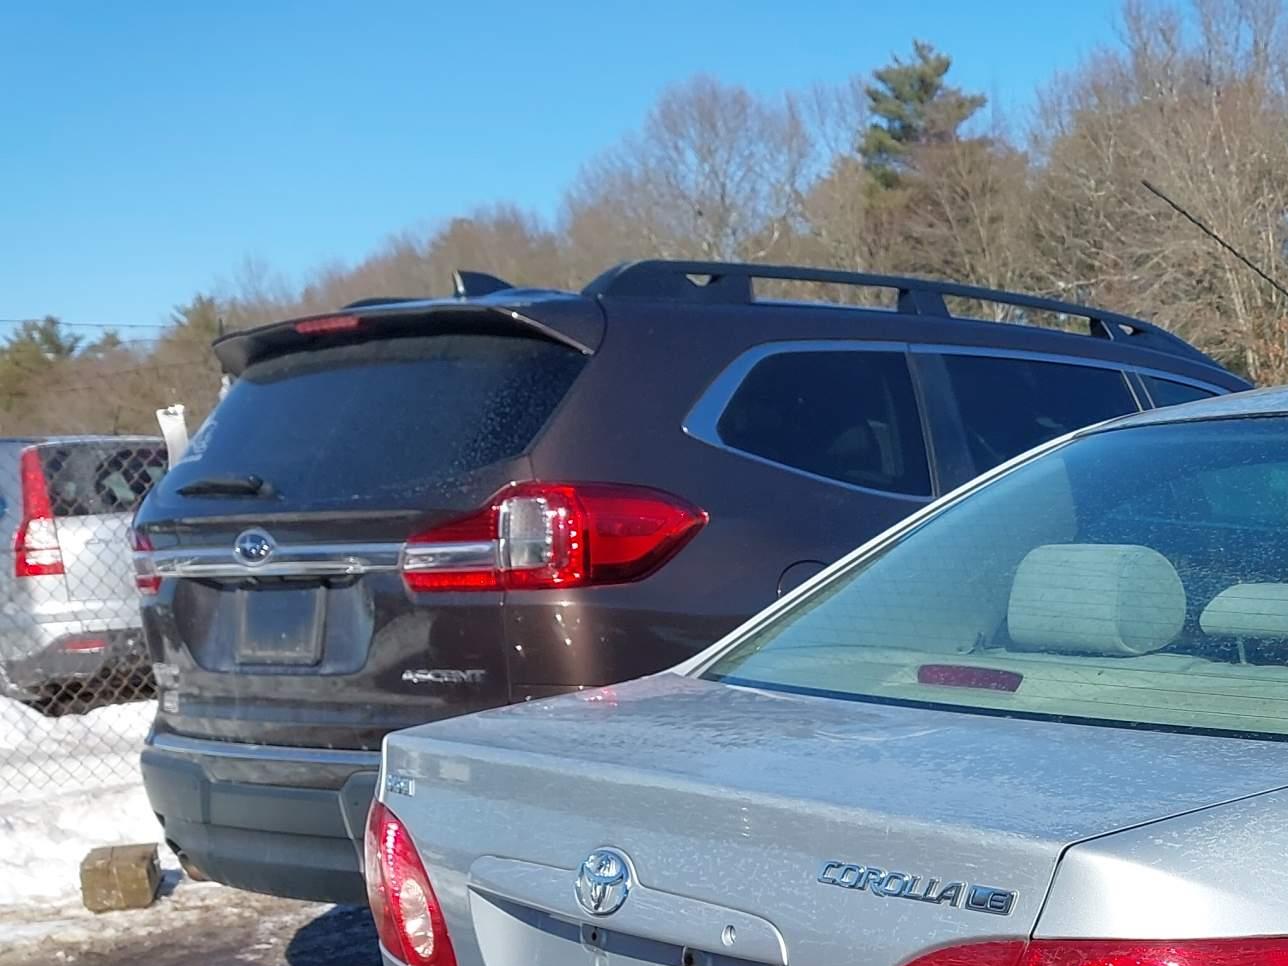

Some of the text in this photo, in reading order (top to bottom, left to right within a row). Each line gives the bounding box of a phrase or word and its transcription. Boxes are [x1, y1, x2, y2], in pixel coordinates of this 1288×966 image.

[401, 669, 486, 683] ASCENT
[818, 861, 1015, 913] COROLLA LE
